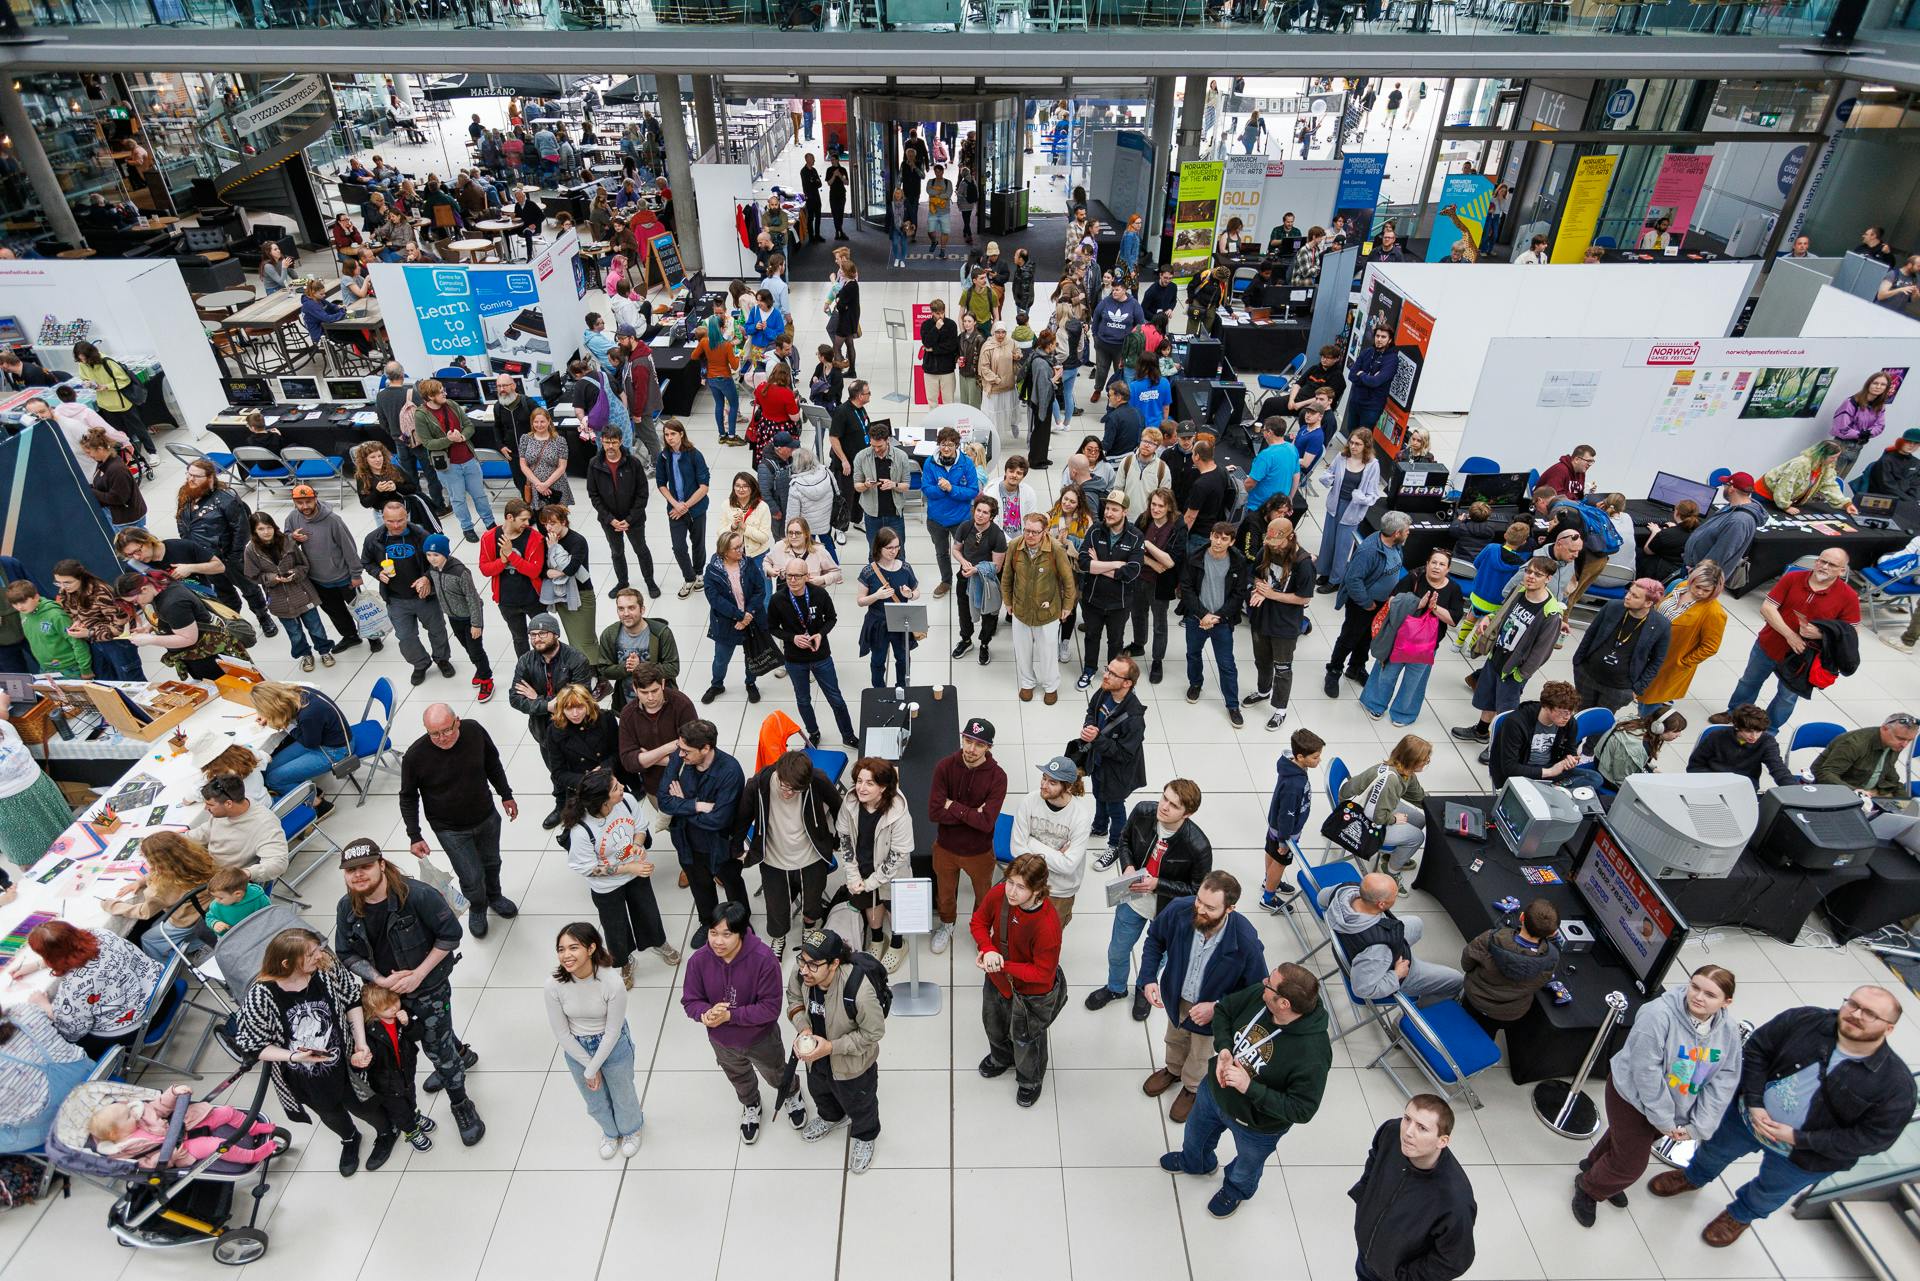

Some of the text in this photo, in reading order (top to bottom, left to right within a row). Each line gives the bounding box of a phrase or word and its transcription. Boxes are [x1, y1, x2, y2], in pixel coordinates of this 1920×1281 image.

[470, 88, 516, 97] MARZANO
[249, 81, 318, 124] PIZZAEXPRESS
[1537, 91, 1566, 129] Lift
[1819, 129, 1844, 171] Norfolk
[1184, 162, 1212, 170] NORWICH
[1222, 192, 1260, 206] GOLD
[1802, 171, 1824, 211] citizens
[1787, 212, 1806, 243] advice
[416, 301, 470, 320] Learn
[479, 299, 513, 311] Gaming
[444, 319, 465, 333] to
[1106, 322, 1126, 330] adidas
[431, 330, 479, 351] Code!
[1652, 348, 1697, 356] NORWICH
[1339, 832, 1359, 850] Norwich
[1601, 839, 1646, 897] RESULT
